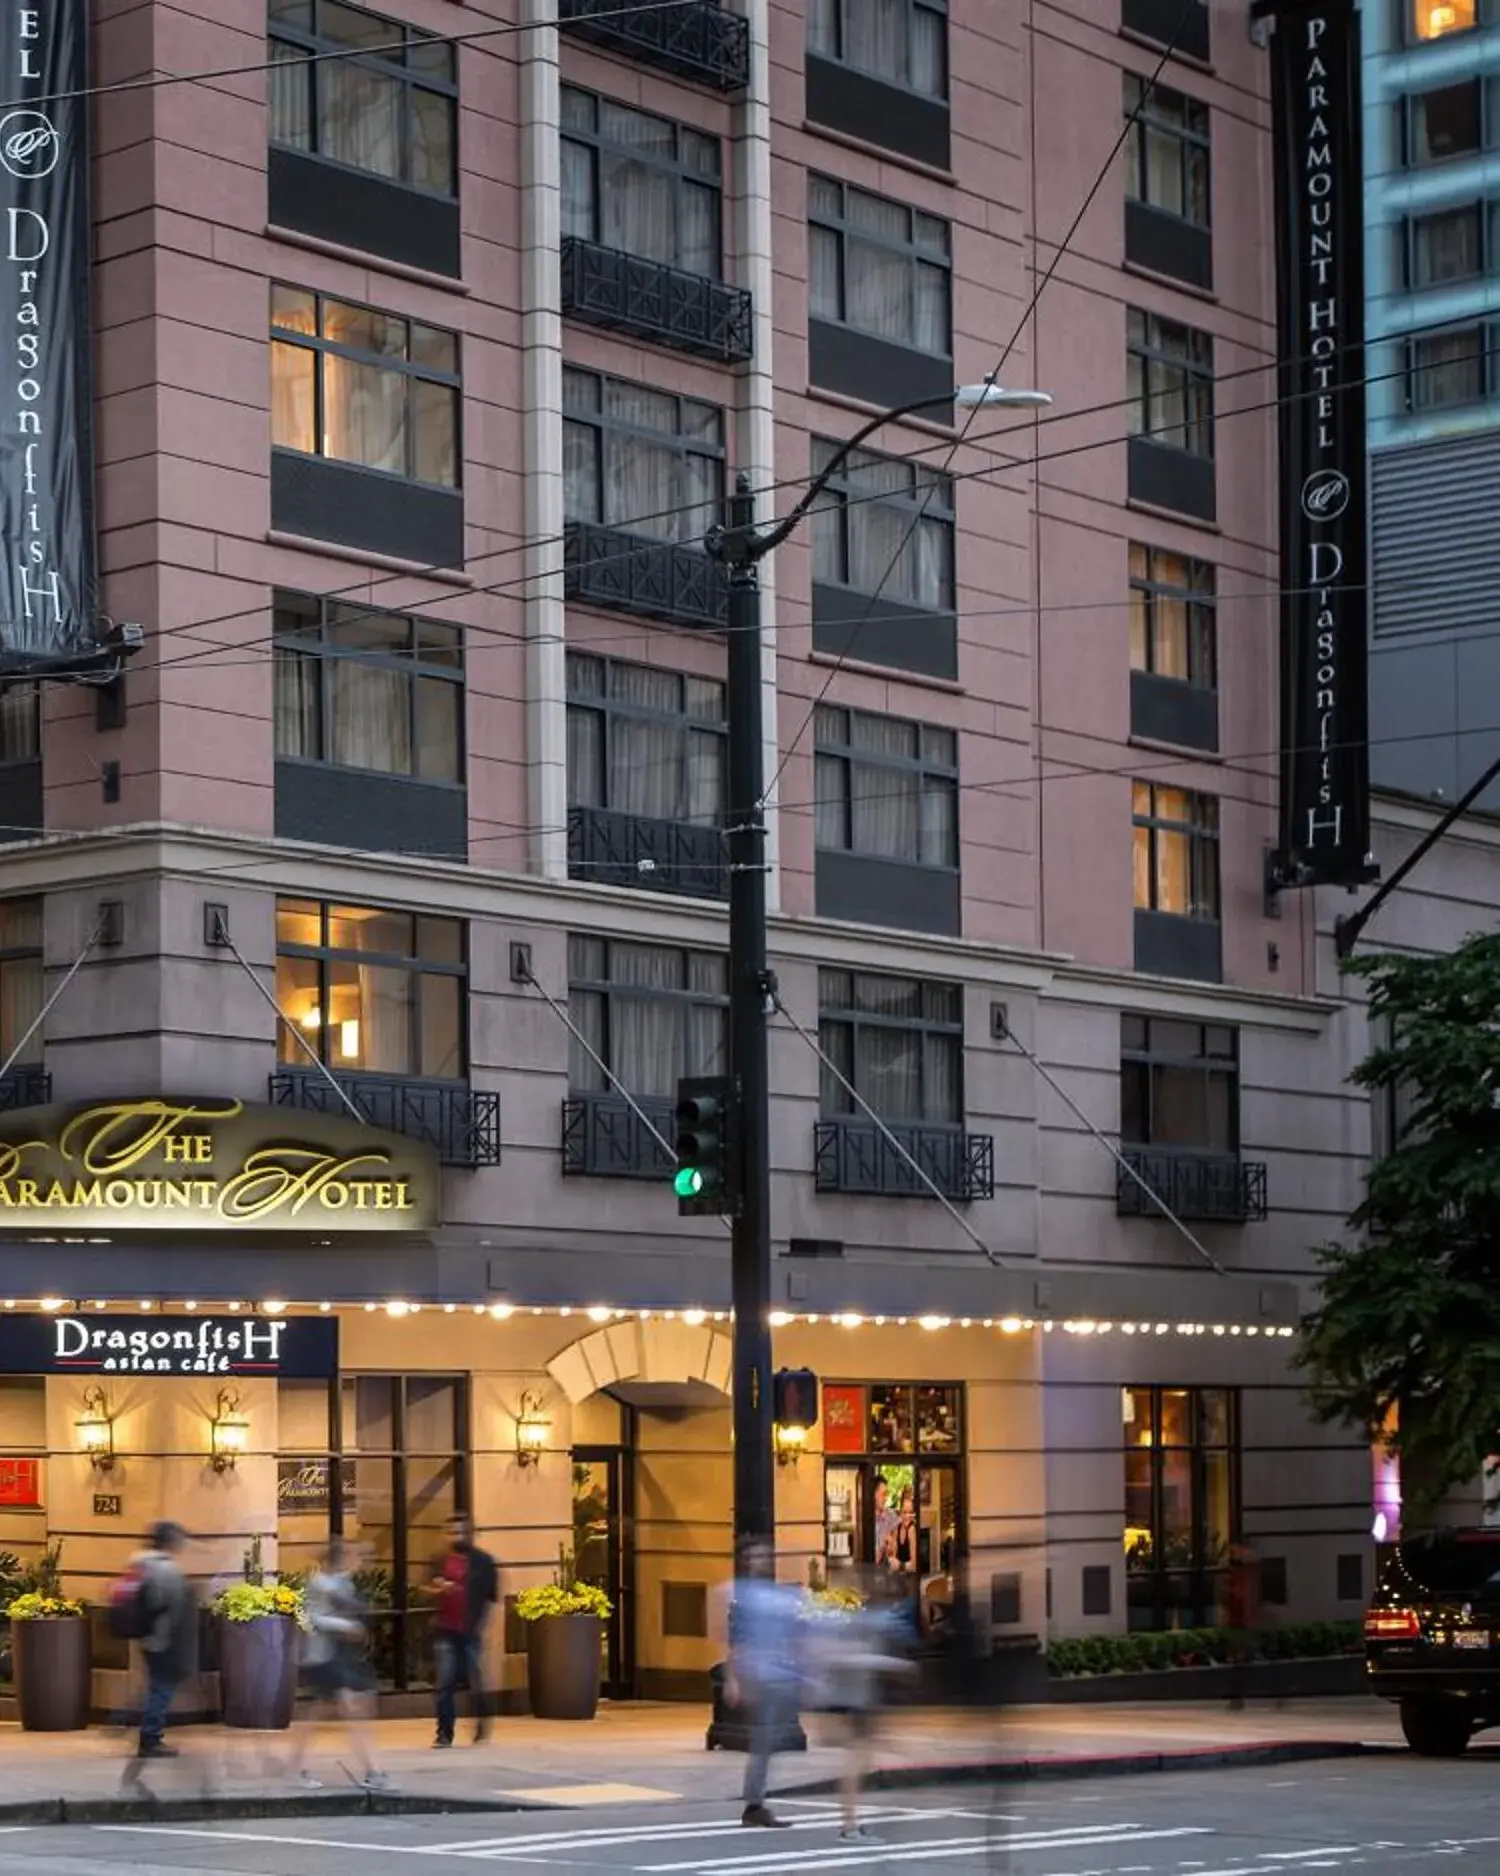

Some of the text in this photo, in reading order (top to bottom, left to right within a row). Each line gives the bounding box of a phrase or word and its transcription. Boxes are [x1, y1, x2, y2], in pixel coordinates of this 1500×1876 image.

[1306, 18, 1336, 448] PARAMOUNT HOTEL
[217, 1149, 413, 1221] HOTEL
[103, 1355, 171, 1371] asian
